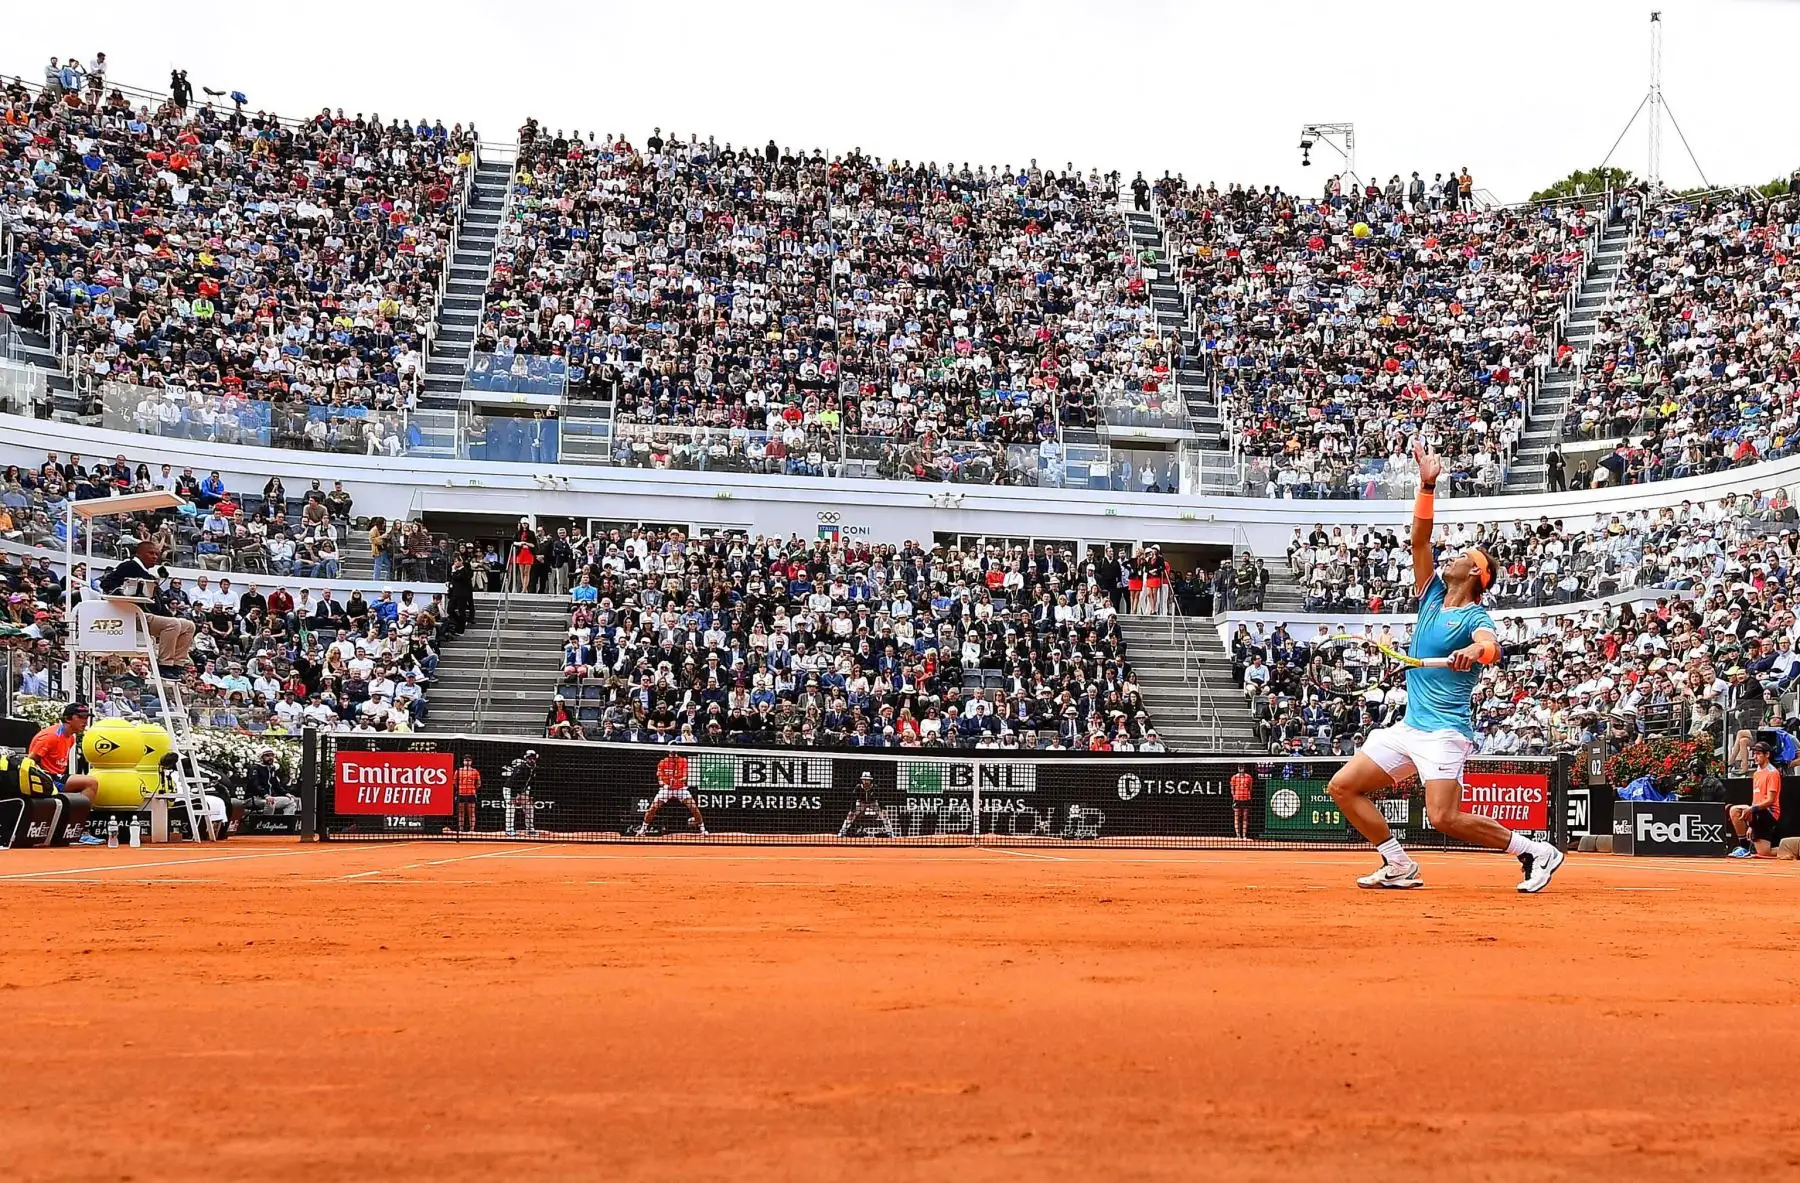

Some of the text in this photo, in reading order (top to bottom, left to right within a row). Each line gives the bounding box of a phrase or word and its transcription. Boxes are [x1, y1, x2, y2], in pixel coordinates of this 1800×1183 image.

[842, 525, 870, 535] CONI
[89, 619, 123, 630] ATP
[341, 762, 448, 785] Emirates
[742, 760, 821, 785] BNL
[1591, 759, 1602, 776] 02
[949, 764, 1025, 788] BNL
[357, 786, 432, 805] FLY BETTER
[1144, 780, 1222, 795] TISCALI
[1460, 783, 1543, 803] Emirates
[480, 799, 556, 810] PEUOT
[697, 794, 822, 810] BNP PARIBAS
[906, 797, 944, 811] BNP
[1310, 795, 1335, 803] ROLE
[1491, 804, 1530, 821] BETTER
[386, 816, 406, 827] 174
[1612, 820, 1633, 835] FedEx
[1636, 813, 1723, 843] FedEx
